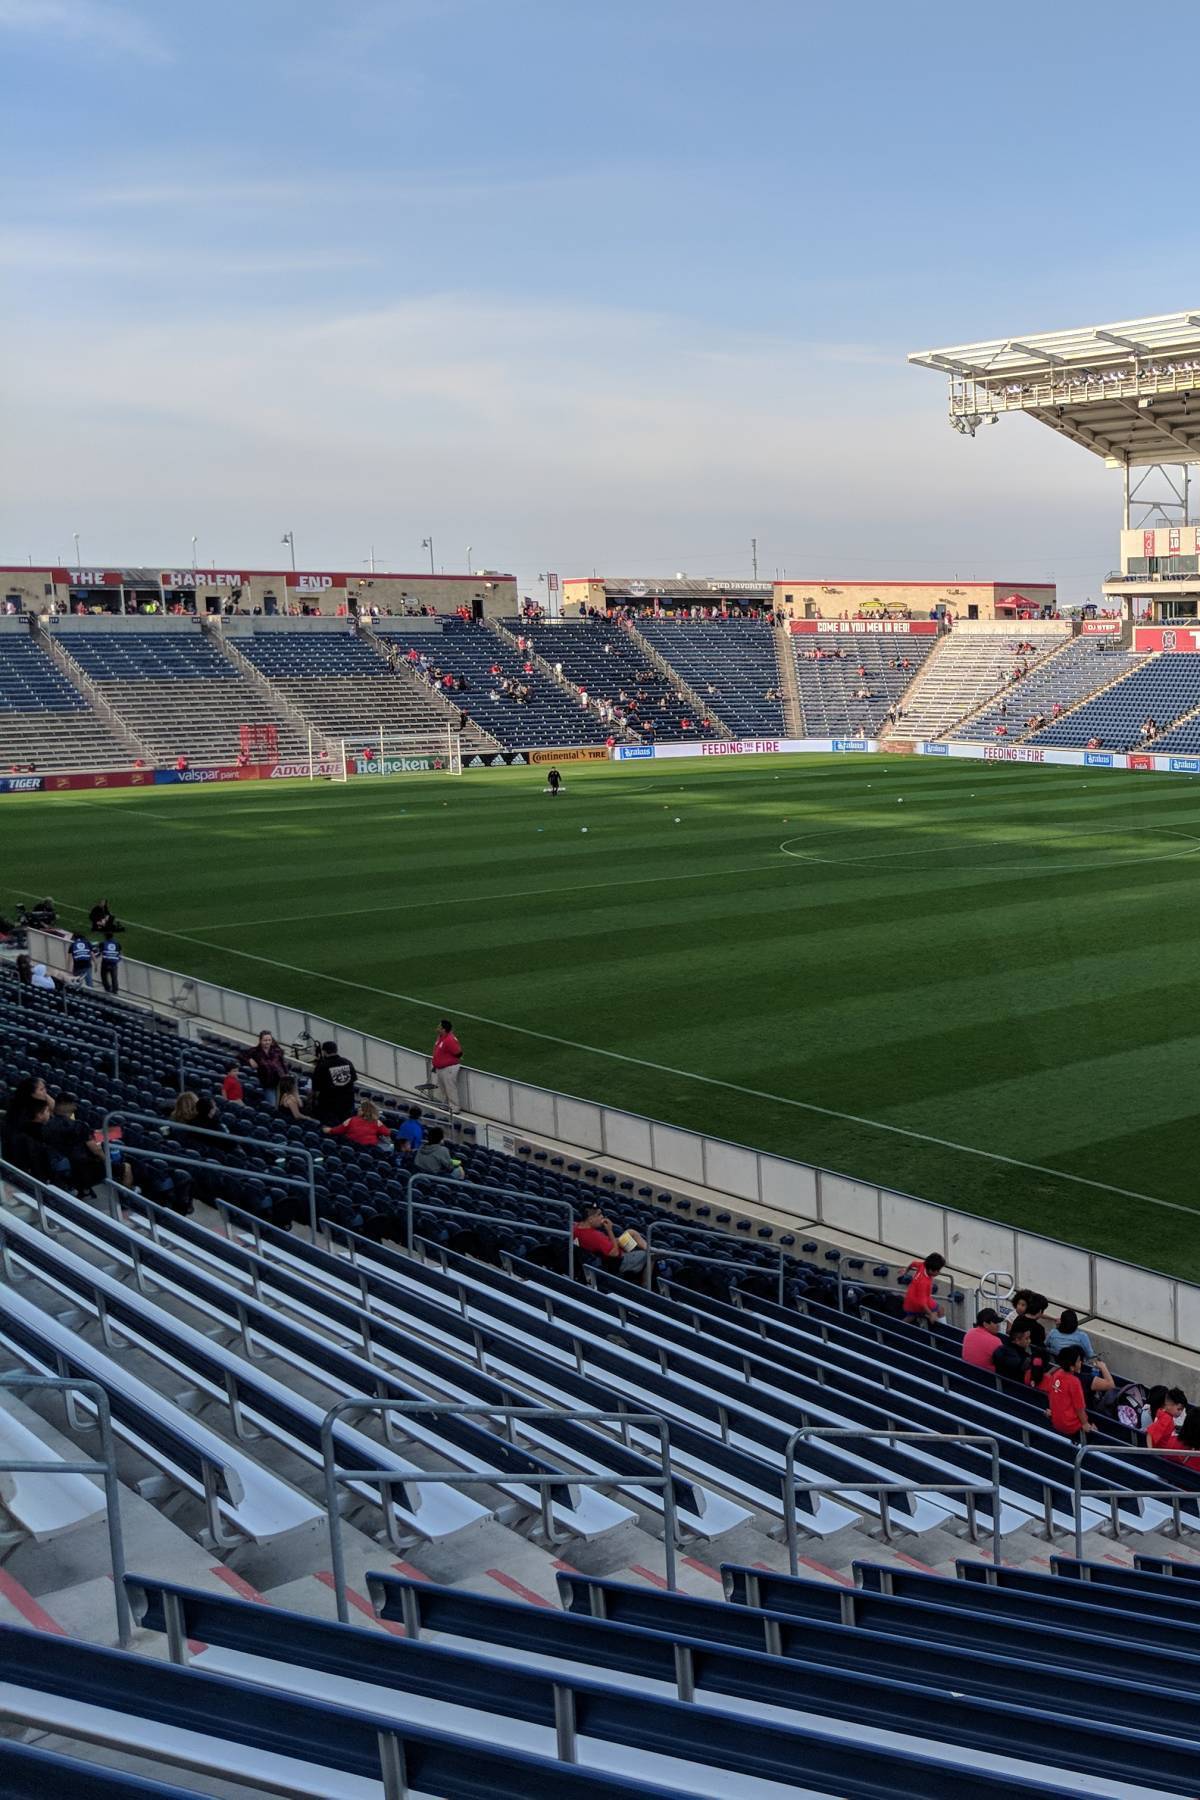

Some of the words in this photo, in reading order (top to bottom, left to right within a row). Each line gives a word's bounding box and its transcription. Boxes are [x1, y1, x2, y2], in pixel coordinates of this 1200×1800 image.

[70, 572, 105, 585] THE
[170, 574, 242, 586] HARLEM
[299, 576, 333, 588] END
[817, 622, 839, 633] COME
[840, 622, 850, 633] ON
[851, 622, 865, 633] YOU
[867, 622, 882, 633] MEN
[884, 622, 892, 633] IN
[702, 742, 743, 754] FEEDING
[756, 741, 779, 752] FIRE
[984, 747, 1017, 760] FEEDING
[1027, 751, 1045, 761] FIRE
[532, 750, 579, 763] Continental
[588, 751, 606, 759] TIRE
[271, 763, 342, 777] ADVOCARE
[357, 757, 429, 774] Heineken
[178, 769, 220, 782] valspar
[8, 778, 41, 789] TIGER
